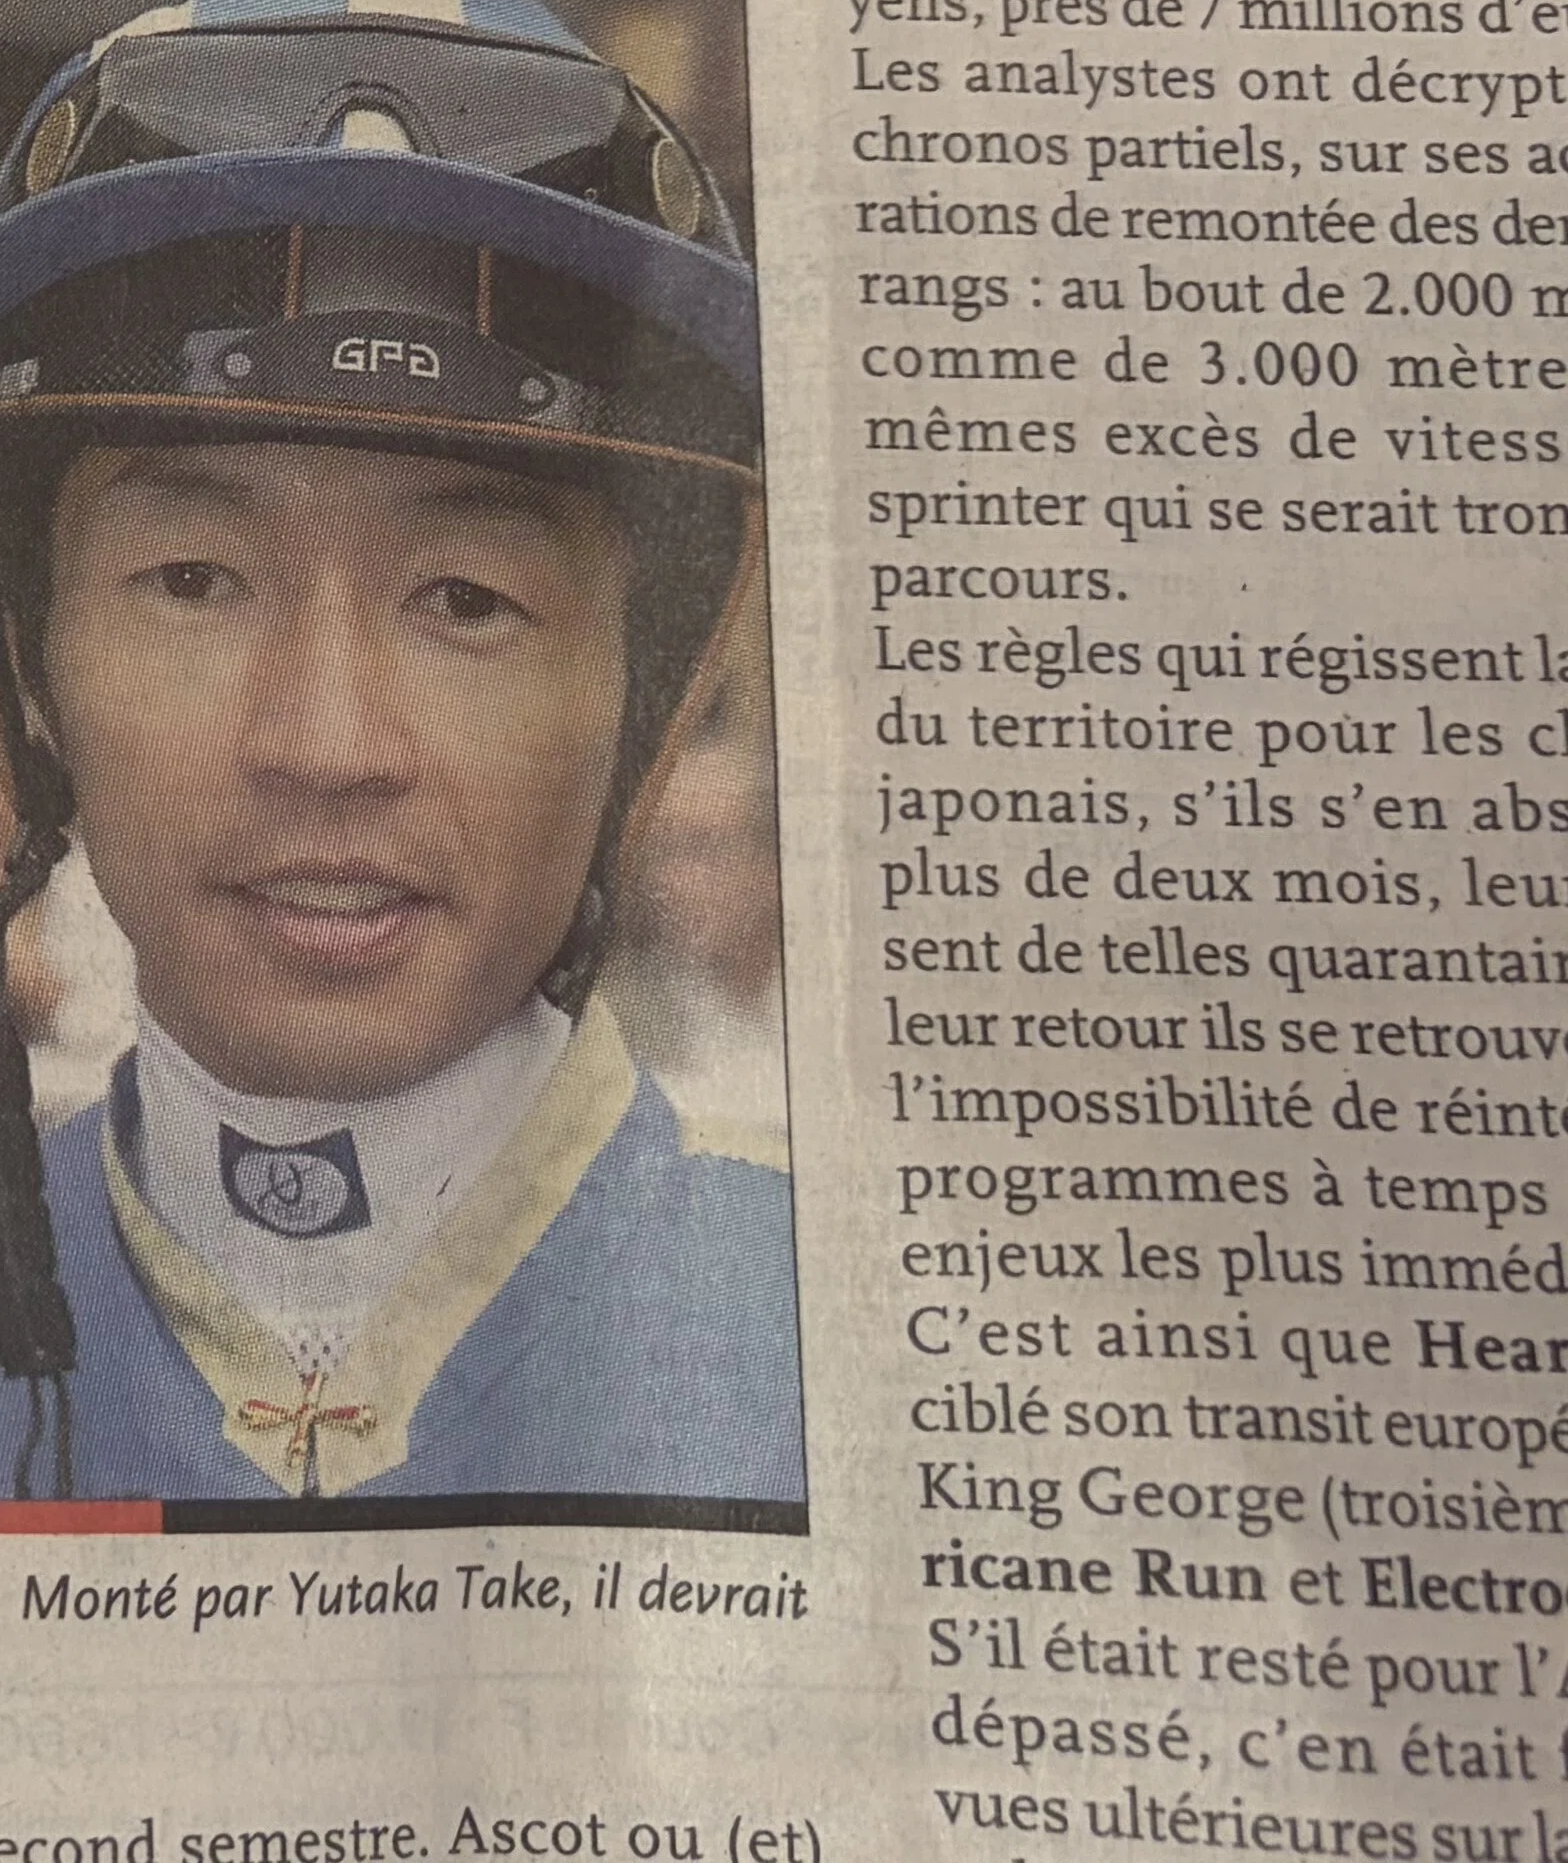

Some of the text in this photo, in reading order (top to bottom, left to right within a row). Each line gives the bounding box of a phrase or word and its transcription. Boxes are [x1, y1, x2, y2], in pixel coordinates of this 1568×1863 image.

[851, 46, 941, 93] Les
[965, 48, 1216, 110] analystes
[1239, 63, 1332, 102] ont
[864, 405, 1077, 454] mêmes
[1105, 411, 1260, 459] excès
[1289, 409, 1357, 461] de
[869, 564, 1128, 612] parcours.
[896, 1157, 1549, 1231] programmes à temps
[22, 1572, 178, 1621] Monté
[192, 1584, 274, 1634] par
[289, 1563, 439, 1617] Yutaka
[455, 1559, 572, 1618] Take,
[594, 1561, 622, 1610] il
[638, 1562, 809, 1620] devrait
[180, 1825, 429, 1863] semestre.
[447, 1805, 607, 1858] Ascot
[628, 1823, 704, 1861] ou
